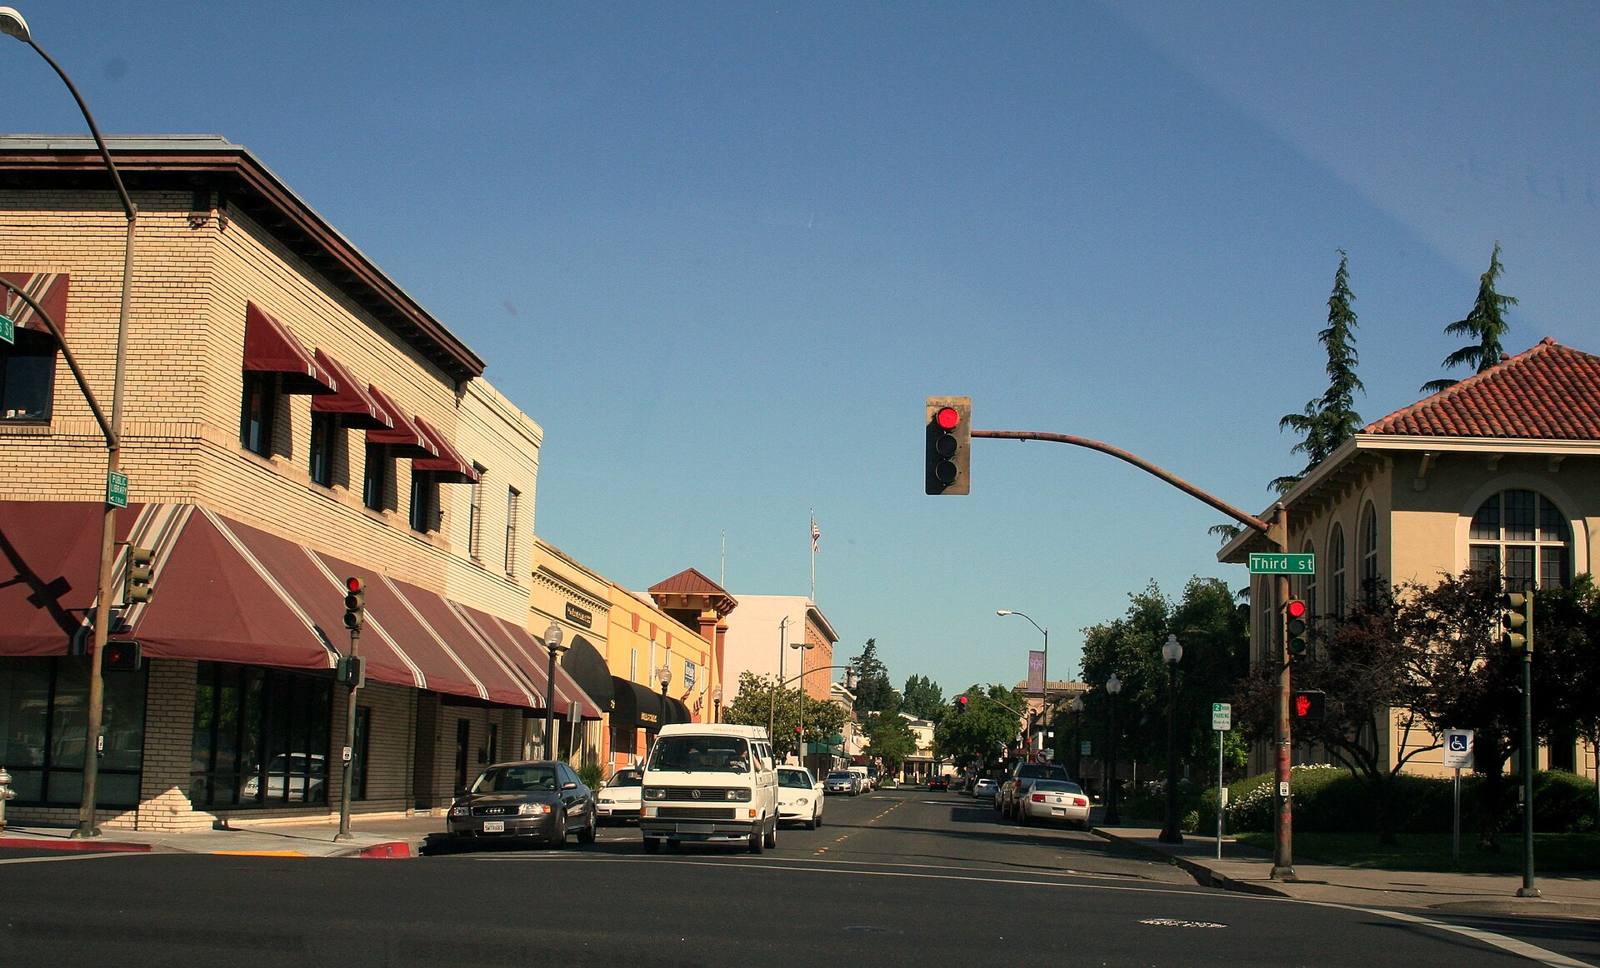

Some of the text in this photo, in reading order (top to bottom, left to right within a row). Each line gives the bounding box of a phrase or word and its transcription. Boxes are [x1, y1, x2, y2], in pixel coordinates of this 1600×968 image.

[112, 474, 127, 486] PUBLIC
[110, 484, 127, 496] LIBRARY
[1251, 557, 1313, 571] Third st
